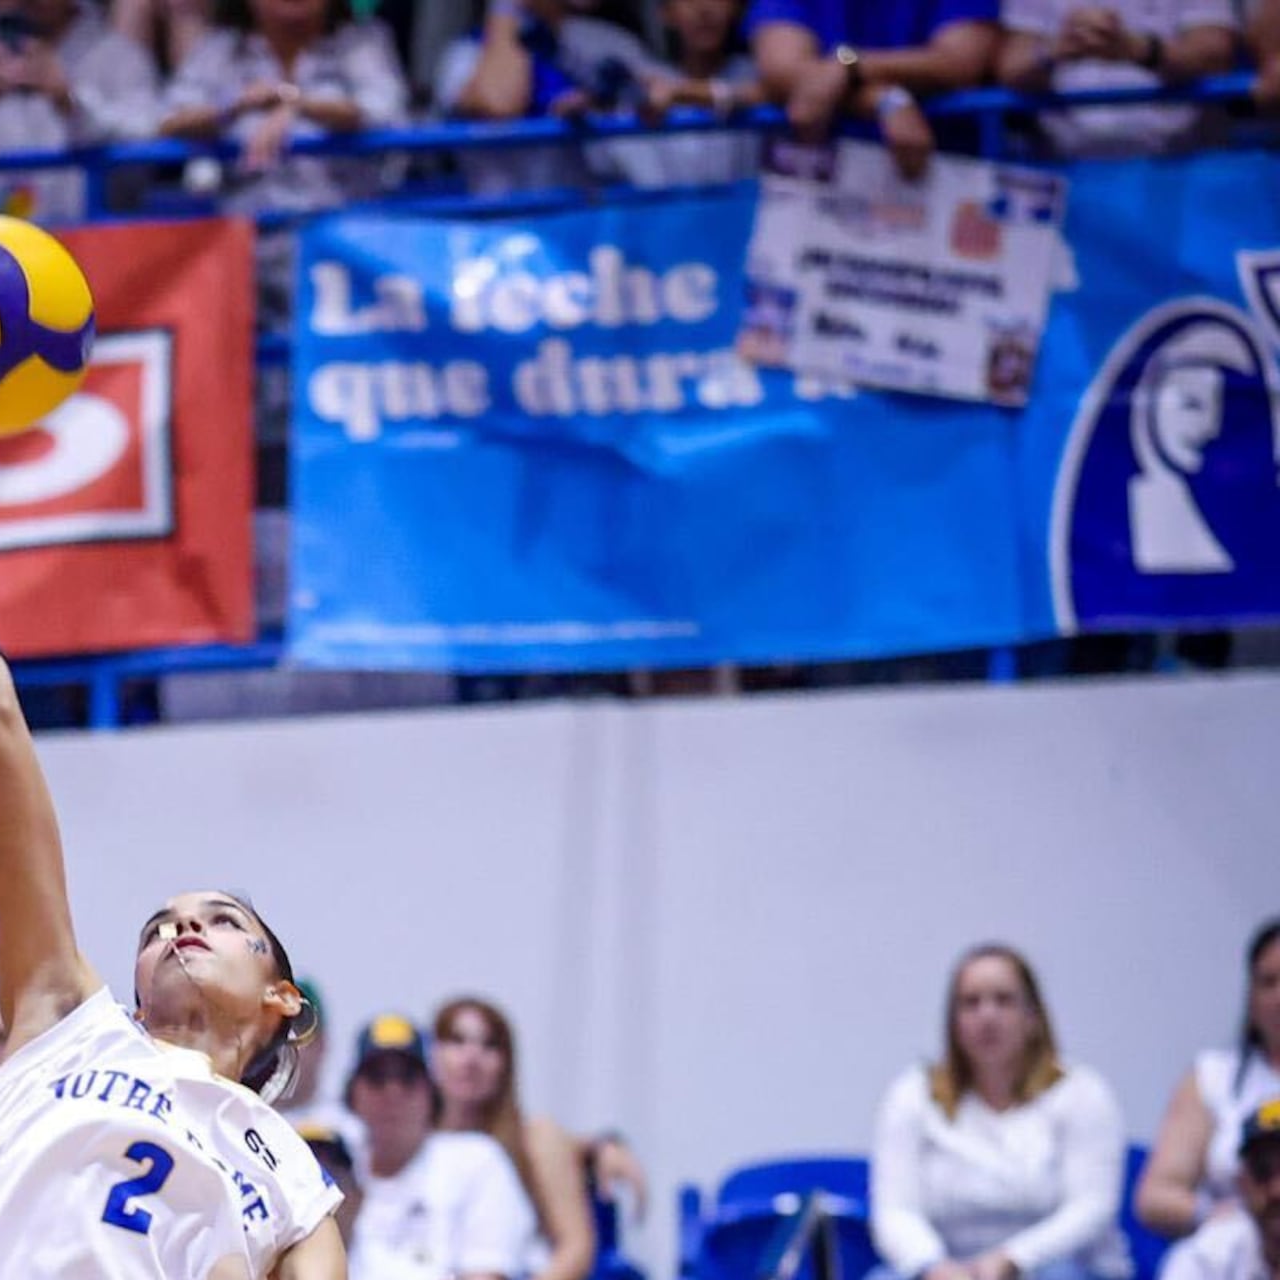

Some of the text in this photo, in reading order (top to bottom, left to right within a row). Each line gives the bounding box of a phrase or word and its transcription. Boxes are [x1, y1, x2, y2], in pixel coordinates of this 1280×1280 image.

[308, 260, 427, 335] La
[450, 244, 719, 333] leche
[308, 360, 492, 443] que
[513, 336, 766, 416] dura
[101, 1140, 176, 1235] 2
